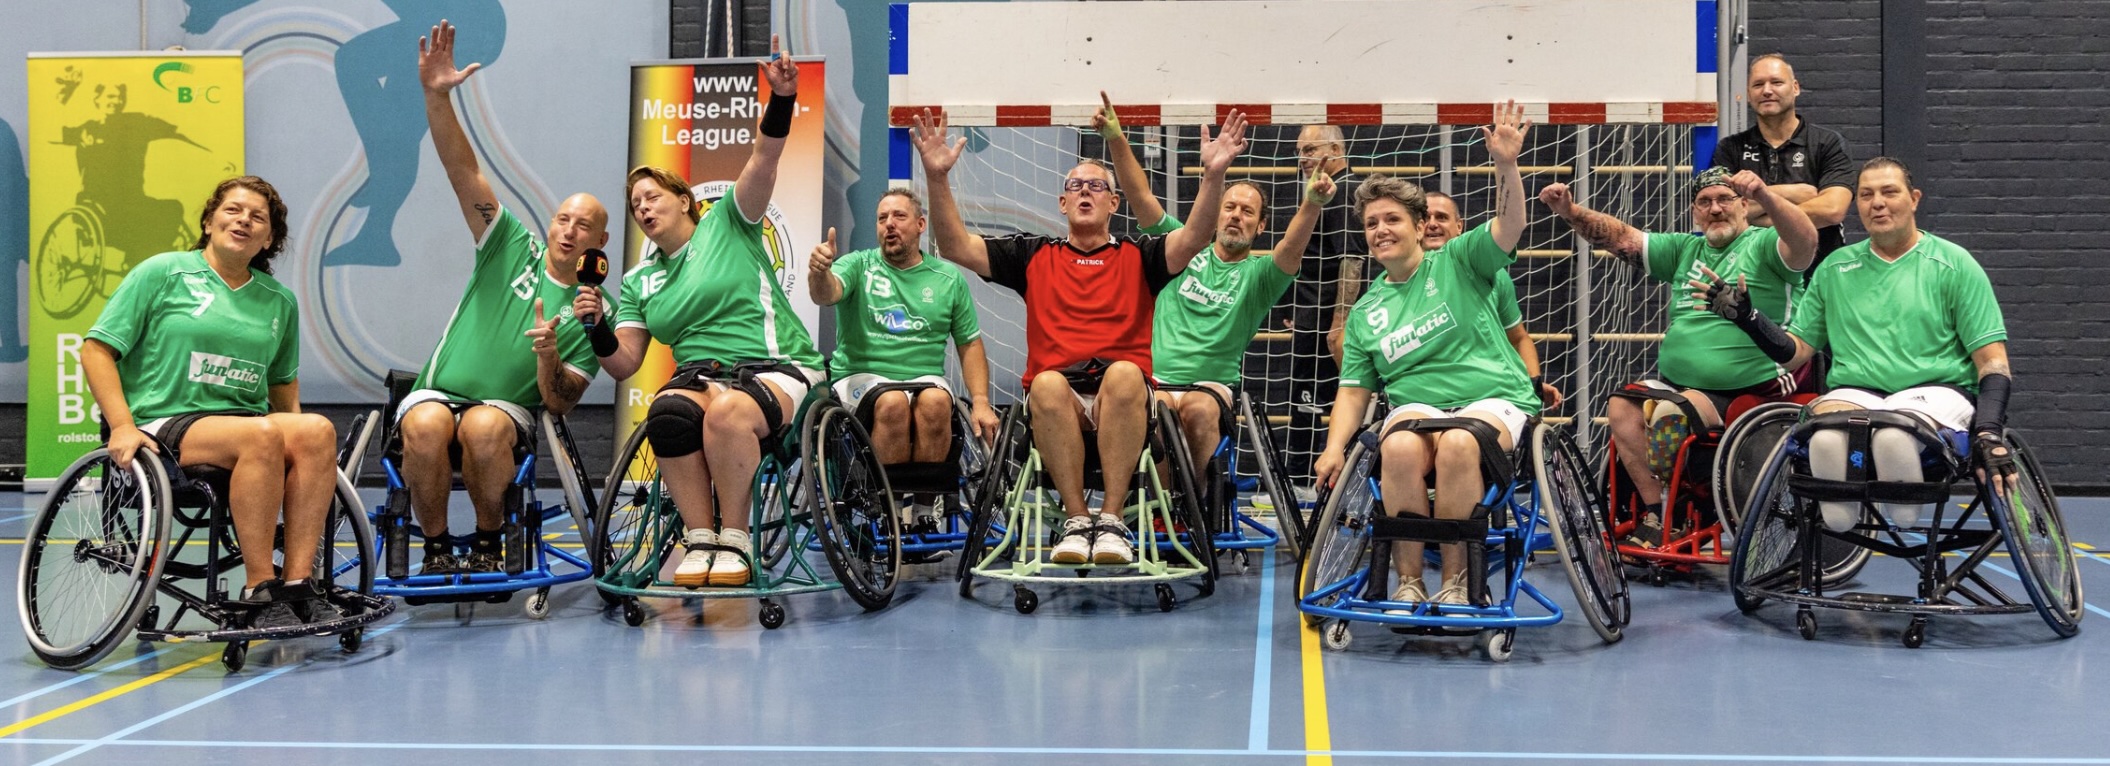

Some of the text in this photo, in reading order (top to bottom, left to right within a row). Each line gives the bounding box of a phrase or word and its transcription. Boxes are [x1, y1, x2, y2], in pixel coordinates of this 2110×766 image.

[693, 76, 757, 93] www.
[643, 97, 810, 120] Meuse-Rh-
[1743, 151, 1760, 162] PC
[704, 184, 732, 195] RHEI
[510, 265, 539, 300] 15
[641, 270, 668, 298] 16
[784, 273, 796, 301] AND
[864, 270, 892, 298] 13
[190, 291, 215, 316] 7
[1367, 307, 1389, 335] 9
[1389, 312, 1449, 358] funatic
[57, 333, 84, 363] R
[194, 358, 260, 384] funatic
[58, 394, 101, 424] Be
[58, 432, 101, 442] rolstoe
